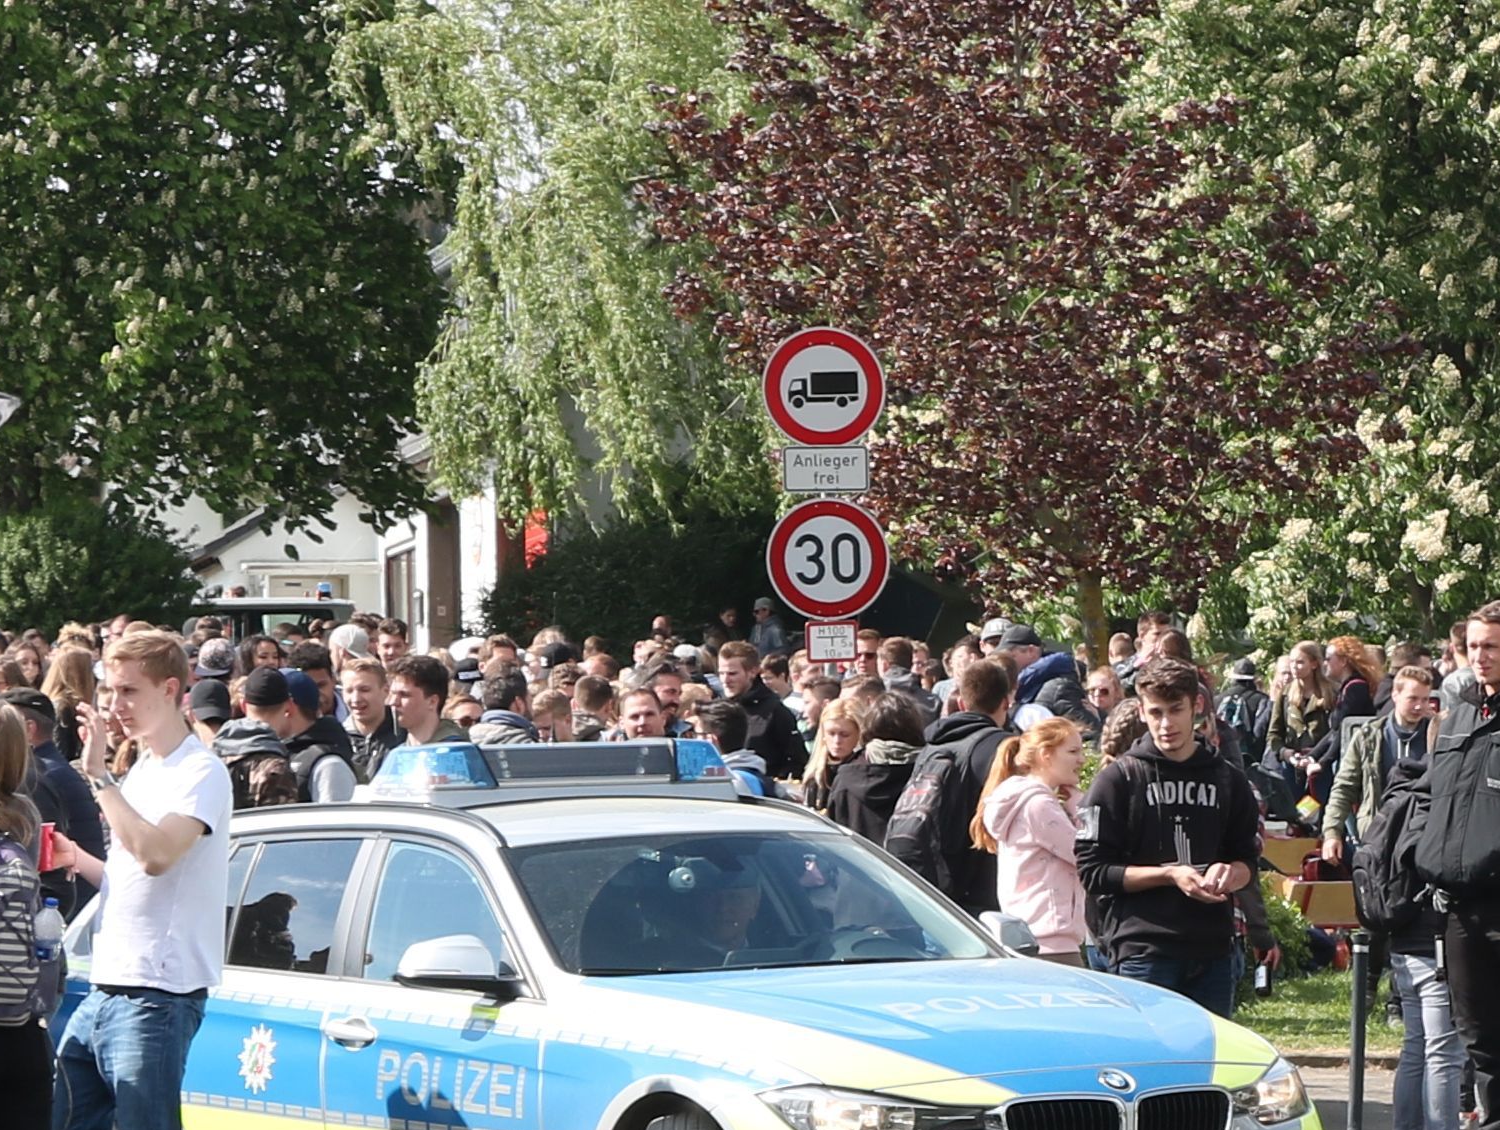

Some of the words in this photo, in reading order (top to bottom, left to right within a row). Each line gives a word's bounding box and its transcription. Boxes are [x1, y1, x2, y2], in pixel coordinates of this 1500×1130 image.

[793, 454, 858, 470] Anlieger
[814, 472, 839, 484] frei
[795, 533, 862, 585] 30
[882, 993, 1131, 1018] POLIZEI
[375, 1049, 526, 1119] POLIZEI
